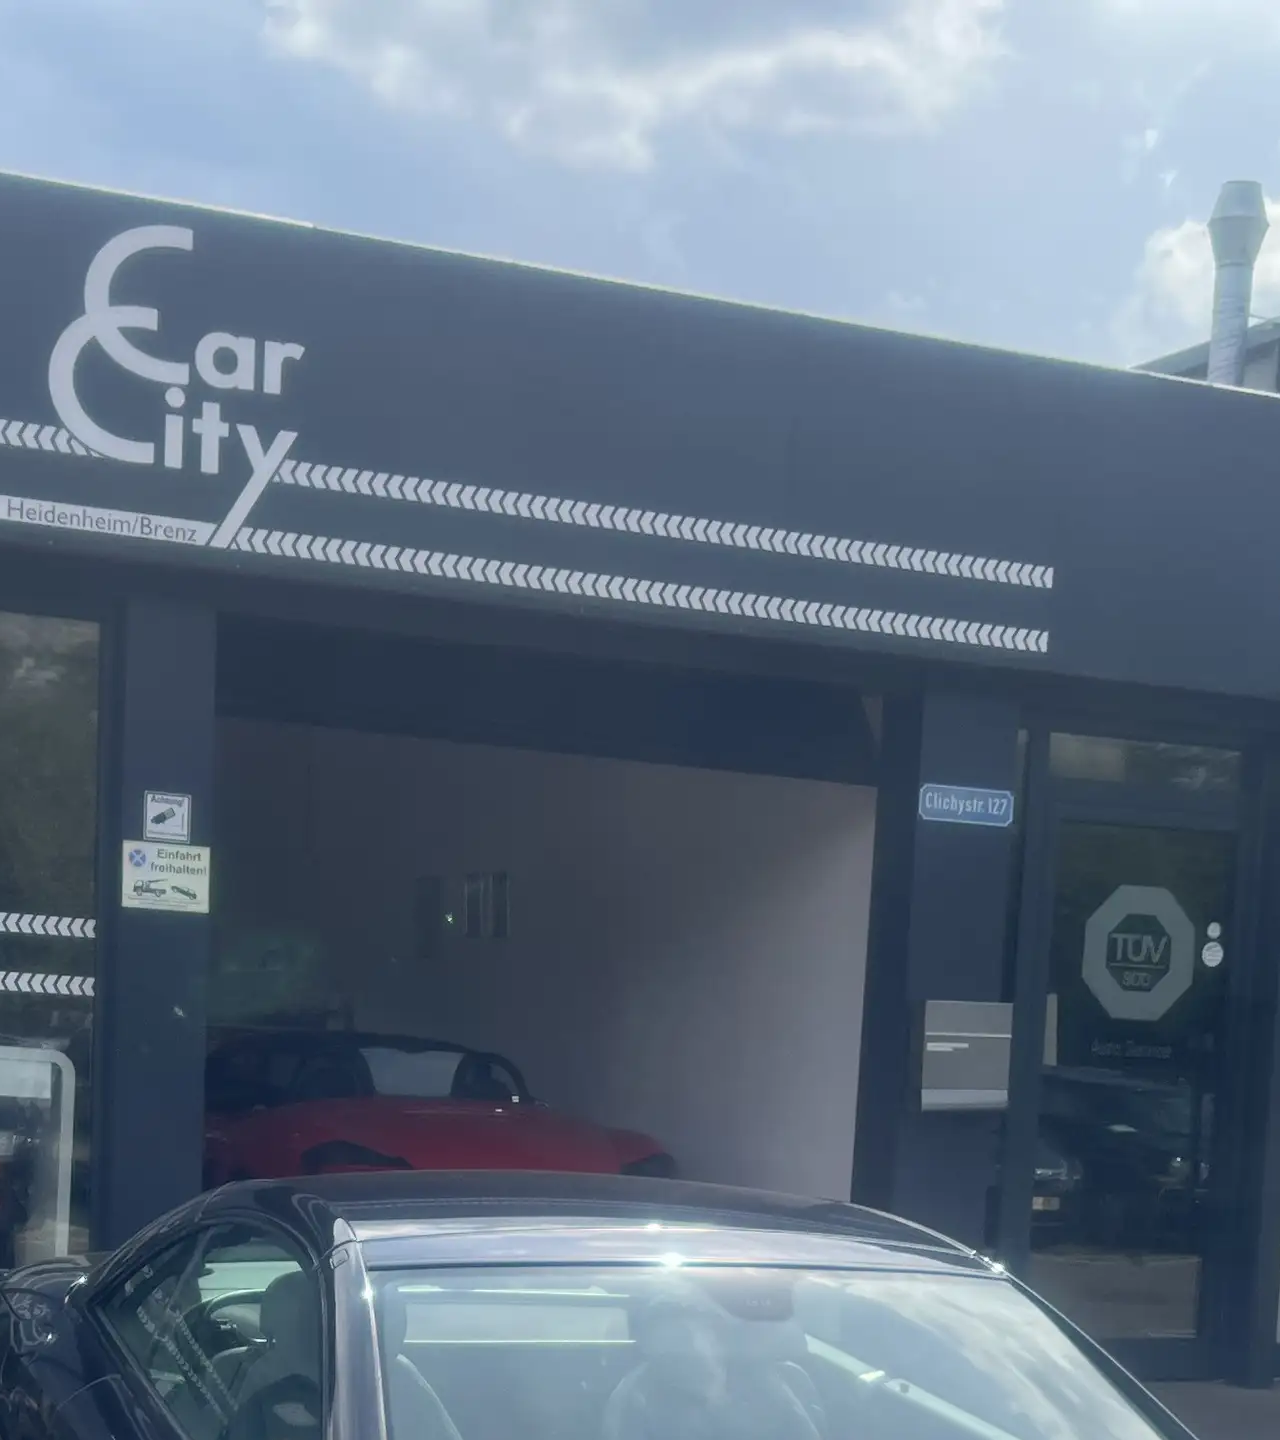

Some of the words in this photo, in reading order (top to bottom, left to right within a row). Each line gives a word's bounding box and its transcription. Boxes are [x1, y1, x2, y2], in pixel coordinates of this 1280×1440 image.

[6, 498, 197, 542] Heidenheim/Brenz
[988, 798, 1008, 815] 127
[156, 848, 202, 862] Einfahrt
